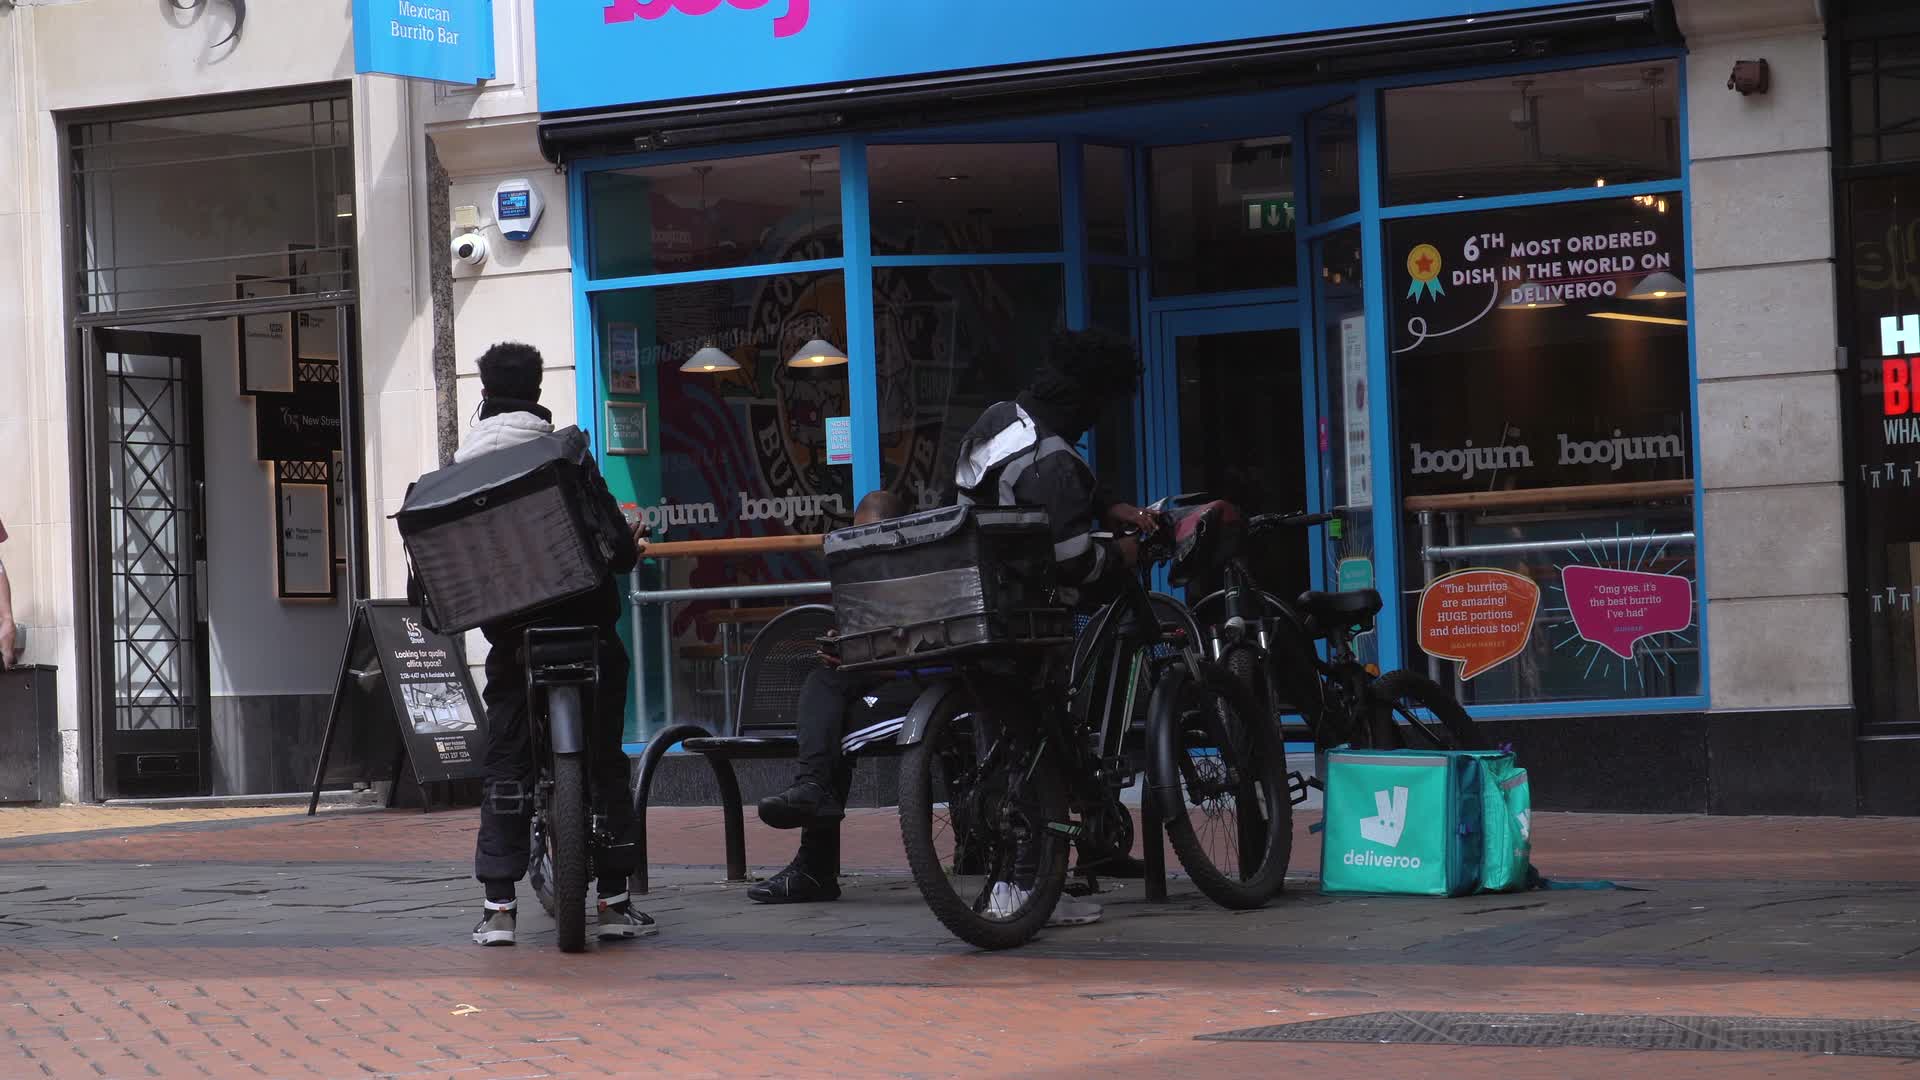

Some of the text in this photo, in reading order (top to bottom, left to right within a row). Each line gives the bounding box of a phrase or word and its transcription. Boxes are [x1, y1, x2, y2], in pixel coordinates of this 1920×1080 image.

[399, 1, 450, 22] Mexican
[391, 20, 459, 45] Burrito Bar
[1463, 230, 1657, 262] 6TH MOST ORDERED
[1452, 252, 1670, 286] DISH IN THE WORLD ON
[1511, 280, 1617, 304] DELIVEROO
[302, 416, 319, 425] New
[321, 416, 341, 426] Stree
[1883, 418, 1920, 445] WHA
[1410, 439, 1534, 480] boojum
[1557, 429, 1685, 471] boojum
[636, 497, 718, 535] oojum
[738, 488, 847, 527] boojum
[1467, 581, 1508, 593] burritos
[1442, 596, 1507, 608] are amazing!
[1590, 595, 1662, 607] the best burrito
[1437, 609, 1513, 623] HUGE portions
[1607, 609, 1624, 619] I've
[1430, 626, 1449, 637] and
[1452, 623, 1498, 636] delicious
[394, 649, 447, 660] Looking for quality
[406, 659, 442, 669] office space?
[1343, 849, 1421, 869] deliveroo
